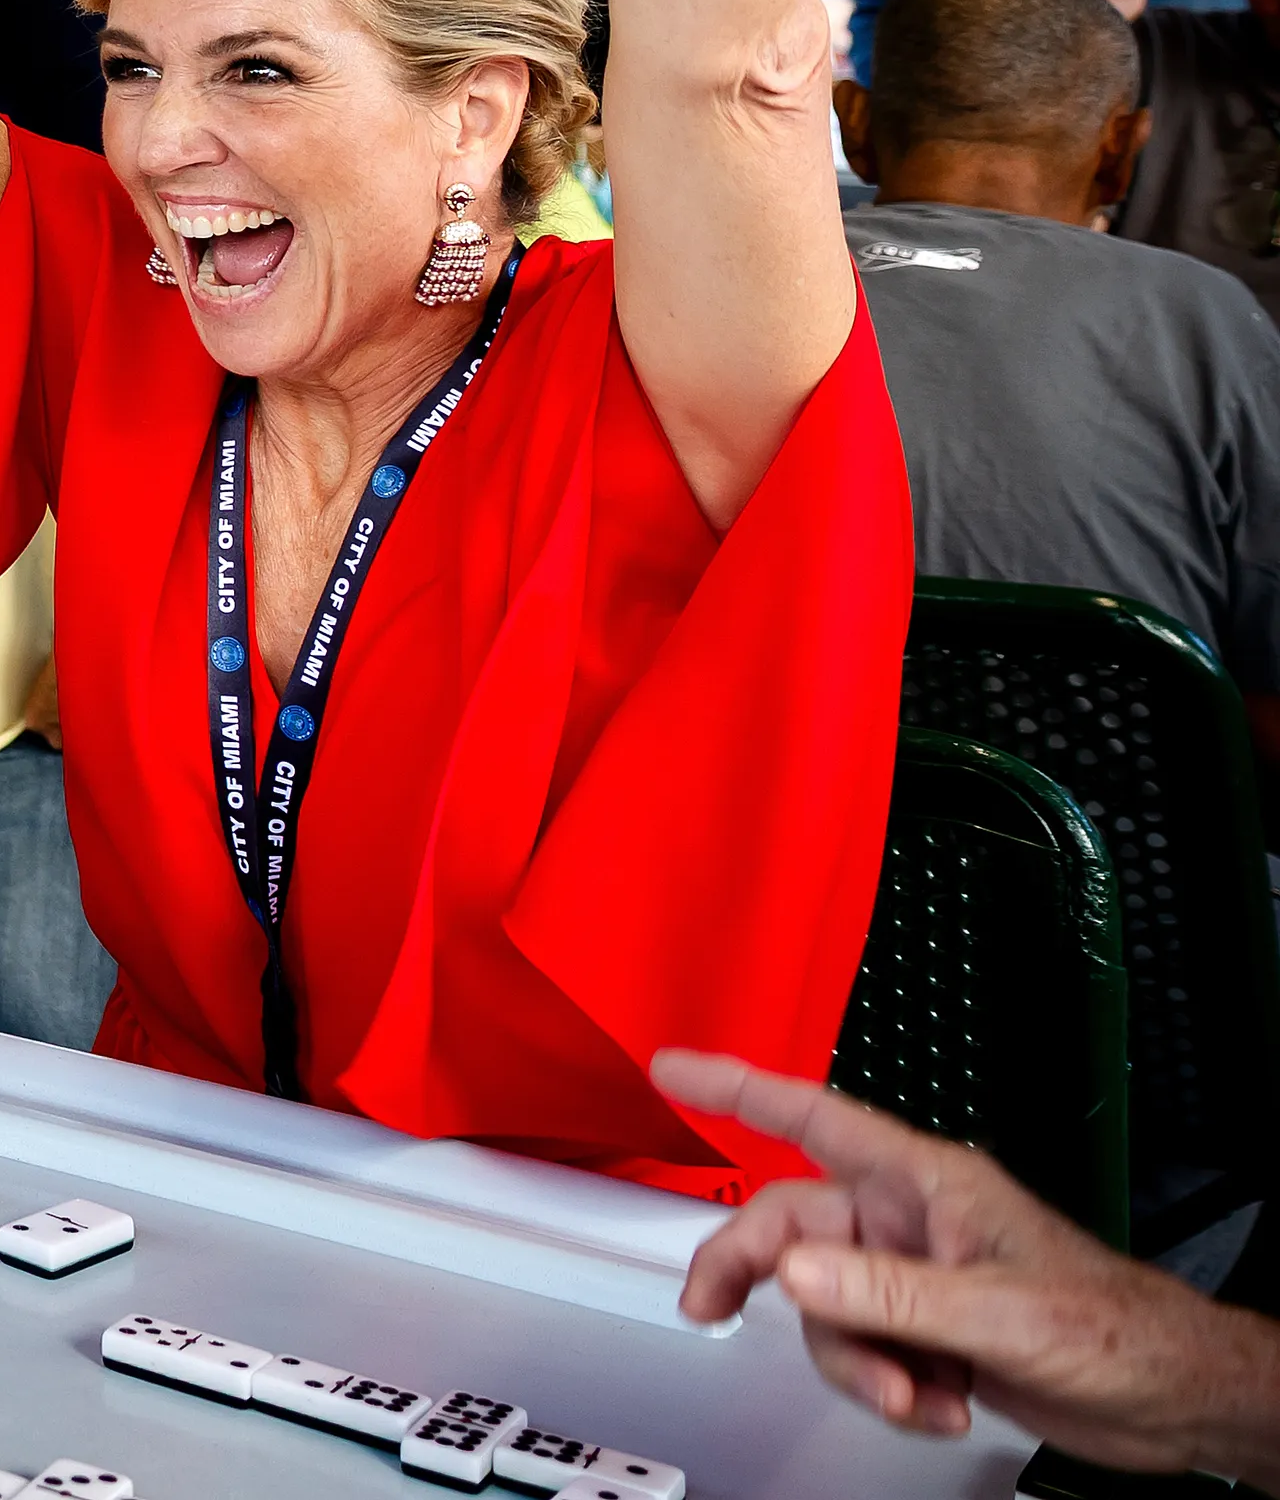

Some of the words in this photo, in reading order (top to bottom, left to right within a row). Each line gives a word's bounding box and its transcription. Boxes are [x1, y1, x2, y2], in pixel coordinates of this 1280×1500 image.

[406, 388, 463, 453] MIAMI
[219, 439, 236, 511] MIAMI
[218, 517, 234, 550] OF
[343, 517, 374, 574] CITY
[218, 556, 236, 614] CITY
[329, 577, 350, 612] OF
[300, 612, 338, 687] MIAMI
[220, 695, 242, 769] MIAMI
[226, 776, 244, 810] OF
[271, 760, 296, 814] CITY
[229, 815, 250, 874] CITY
[268, 818, 286, 848] OF
